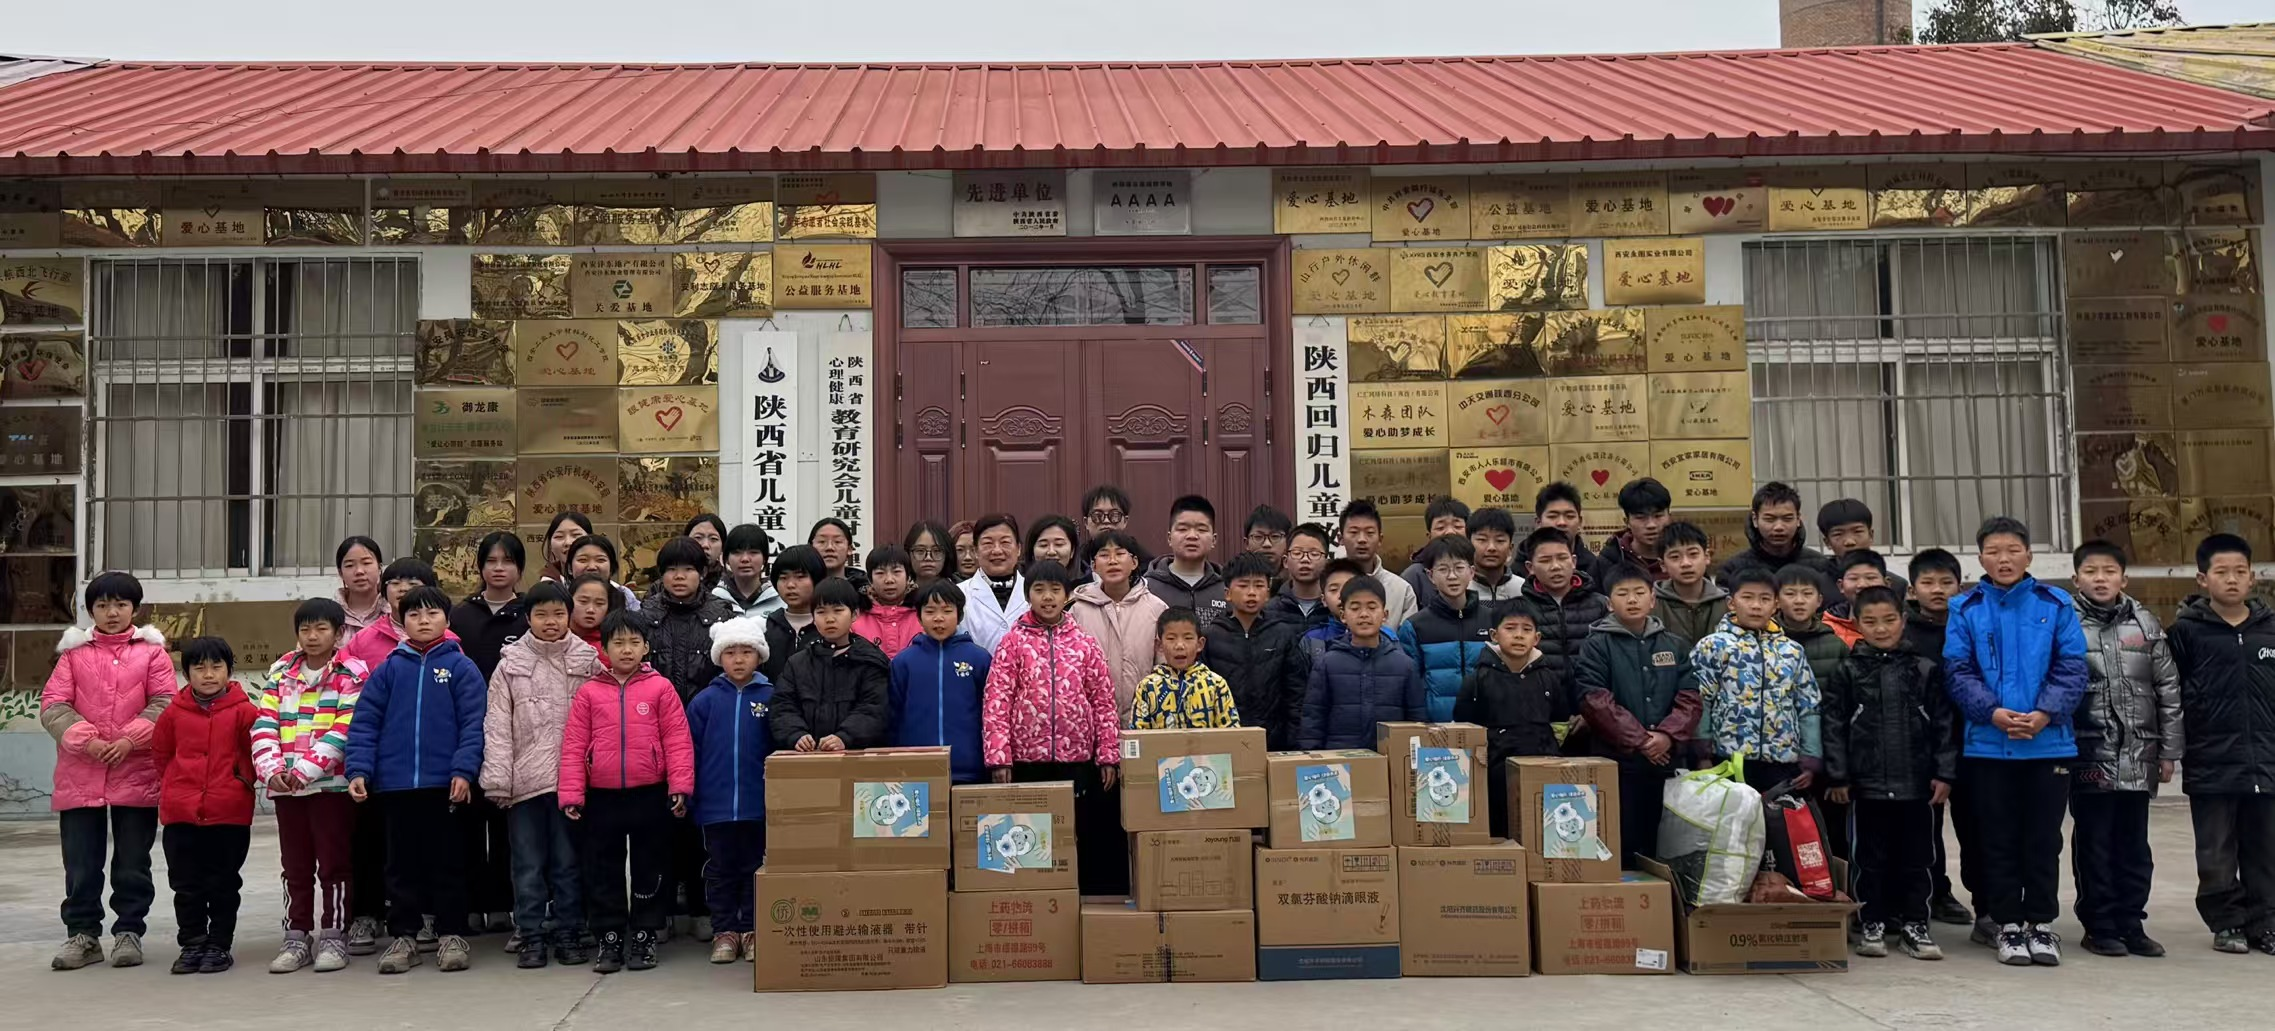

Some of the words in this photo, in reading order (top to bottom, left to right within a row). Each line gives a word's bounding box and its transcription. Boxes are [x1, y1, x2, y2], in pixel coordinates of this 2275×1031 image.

[965, 182, 1053, 202] 先进单位
[1285, 191, 1359, 208] 爱心基地
[1110, 193, 1176, 208] AAAA
[1585, 197, 1654, 213] 爱心基地
[1780, 199, 1858, 212] 爱心基地
[1488, 201, 1553, 216] 公益基地
[180, 221, 246, 235] 爱心基地
[1401, 227, 1441, 237] 爱心基地
[816, 260, 843, 270] HLHL
[1300, 253, 1381, 284] 山行户外休闲群
[1617, 270, 1695, 287] 爱心基地
[784, 284, 862, 297] 公益服务基地
[594, 302, 653, 313] 关爱基地
[2195, 335, 2243, 348] 爱心基地
[1664, 351, 1732, 363] 爱心基地
[828, 356, 845, 406] 心理健康
[461, 400, 500, 413] 御龙康
[1458, 389, 1541, 411] 中天交通陕西分公司
[1362, 404, 1436, 421] 木森团队
[1561, 399, 1637, 417] 爱心基地
[1362, 426, 1437, 438] 爱心助梦成长
[1660, 450, 1742, 471] 西安宜家家居有限公司
[1457, 458, 1543, 485] 西安市人人乐超市有限公司
[525, 464, 612, 499] 陕西省公安厅机场公安局
[1483, 493, 1520, 503] 爱心基地
[1684, 488, 1718, 497] 爱心基地
[532, 502, 603, 515] 爱心教育基地
[1211, 599, 1227, 609] DIOR
[1204, 836, 1228, 845] Joyoung
[1277, 891, 1380, 905] 双氯芬酸钠滴眼液
[1639, 893, 1650, 910] 3
[988, 900, 1033, 915] 上药物流
[1047, 898, 1059, 914] 3
[772, 922, 894, 937] 一次性使用避光输液器
[904, 921, 928, 934] 带针
[1730, 933, 1758, 948] 0.9%
